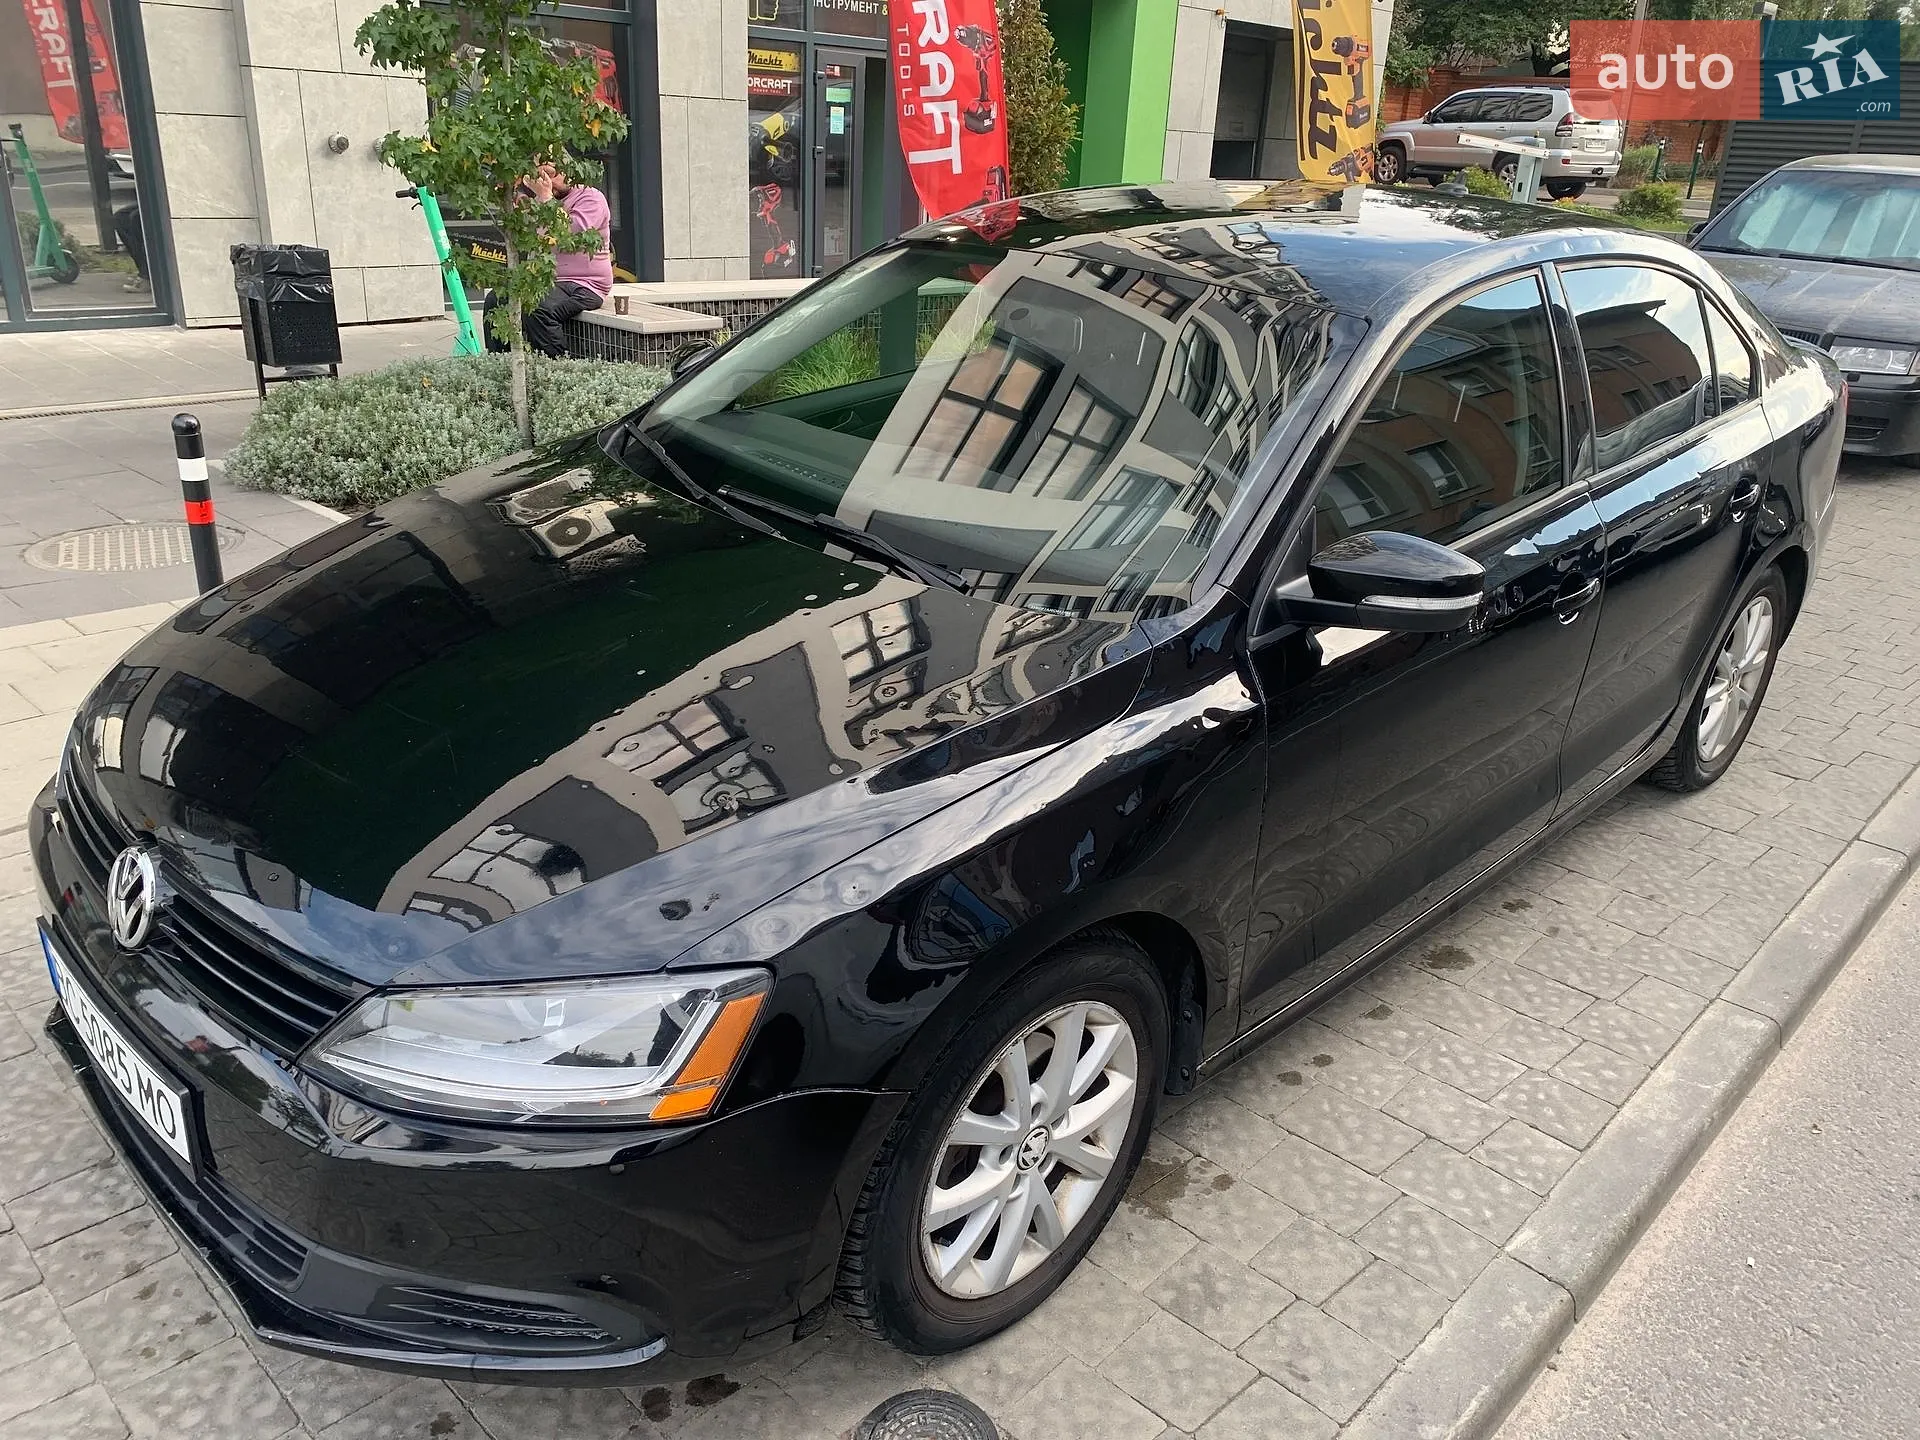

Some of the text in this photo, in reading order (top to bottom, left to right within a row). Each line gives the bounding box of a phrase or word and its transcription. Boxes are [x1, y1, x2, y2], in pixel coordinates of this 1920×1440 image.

[896, 23, 916, 116] TOOLS
[80, 1000, 132, 1095] 5085
[134, 1062, 176, 1140] MO
